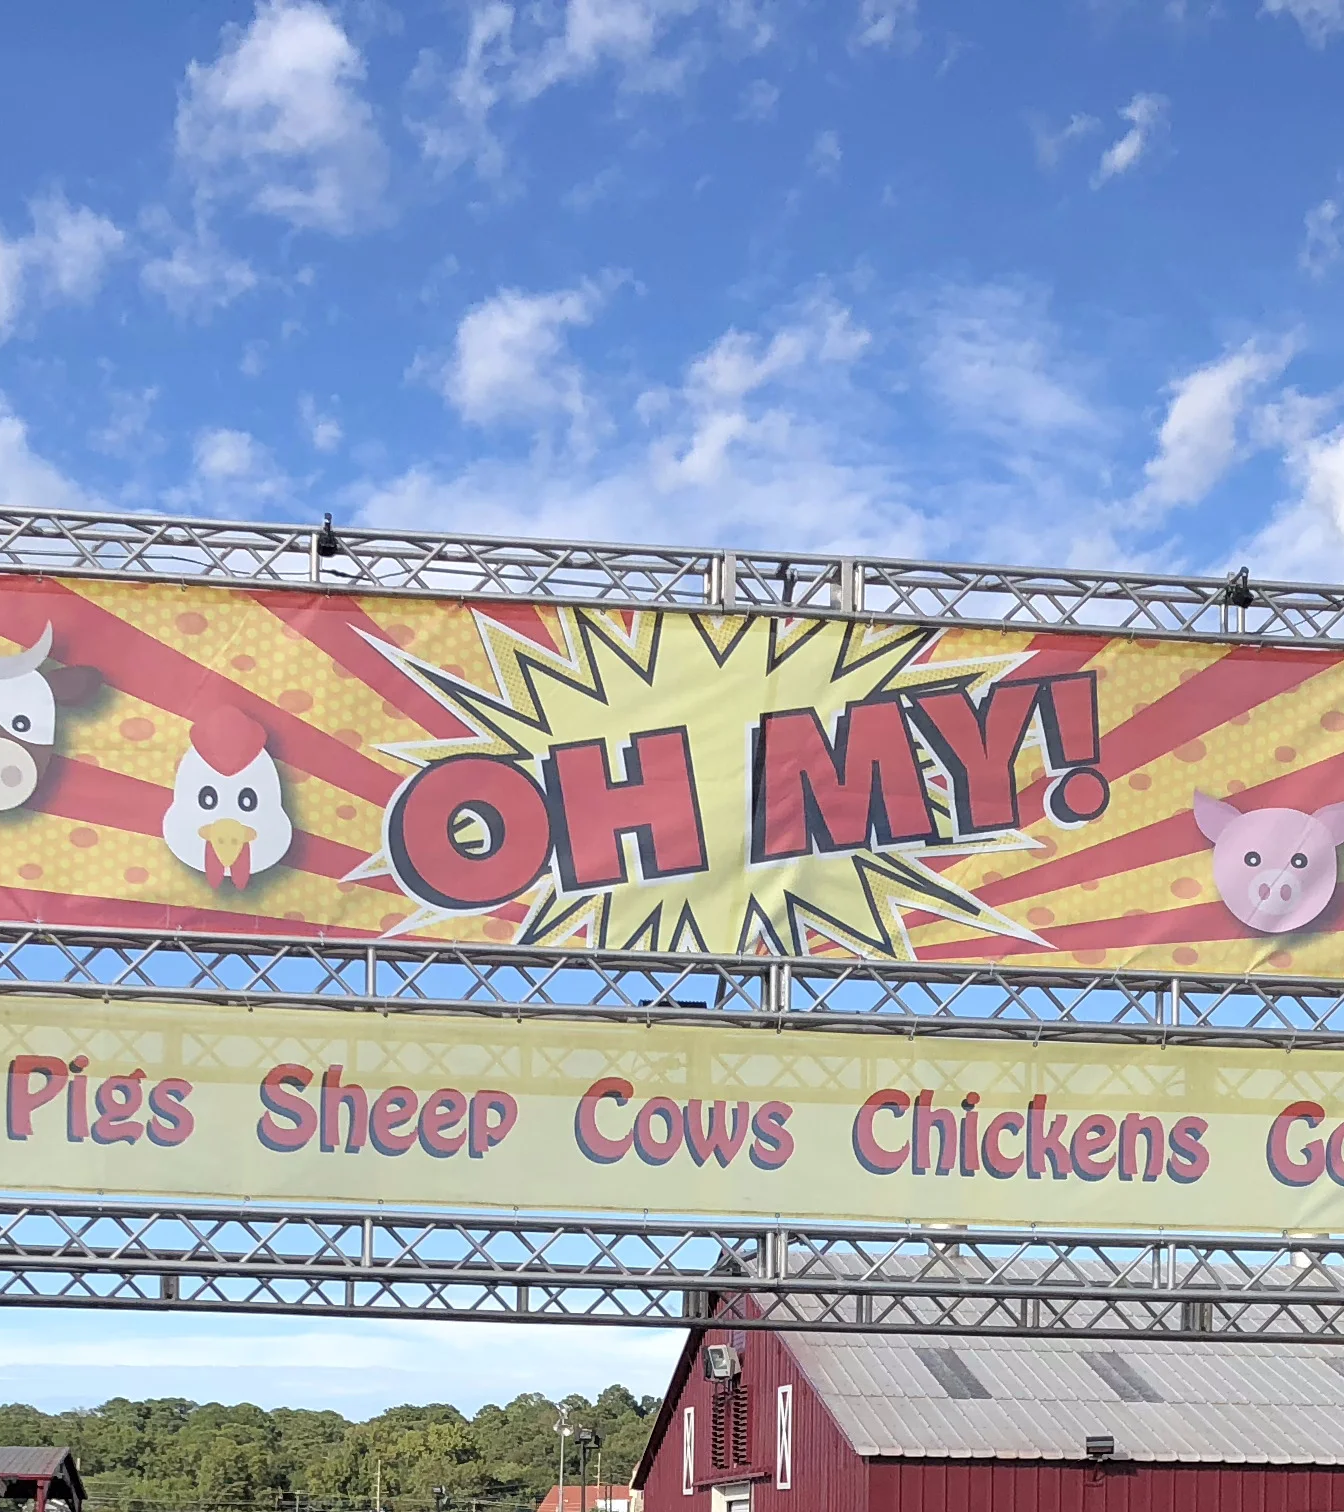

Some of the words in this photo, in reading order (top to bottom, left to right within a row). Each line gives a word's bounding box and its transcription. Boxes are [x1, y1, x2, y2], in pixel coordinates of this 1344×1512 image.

[389, 725, 709, 909] OH
[749, 671, 1110, 865] MY!
[5, 1053, 196, 1147] Pigs
[256, 1062, 519, 1160] Sheep
[574, 1076, 795, 1170] Cows
[851, 1087, 1211, 1184] Chickens
